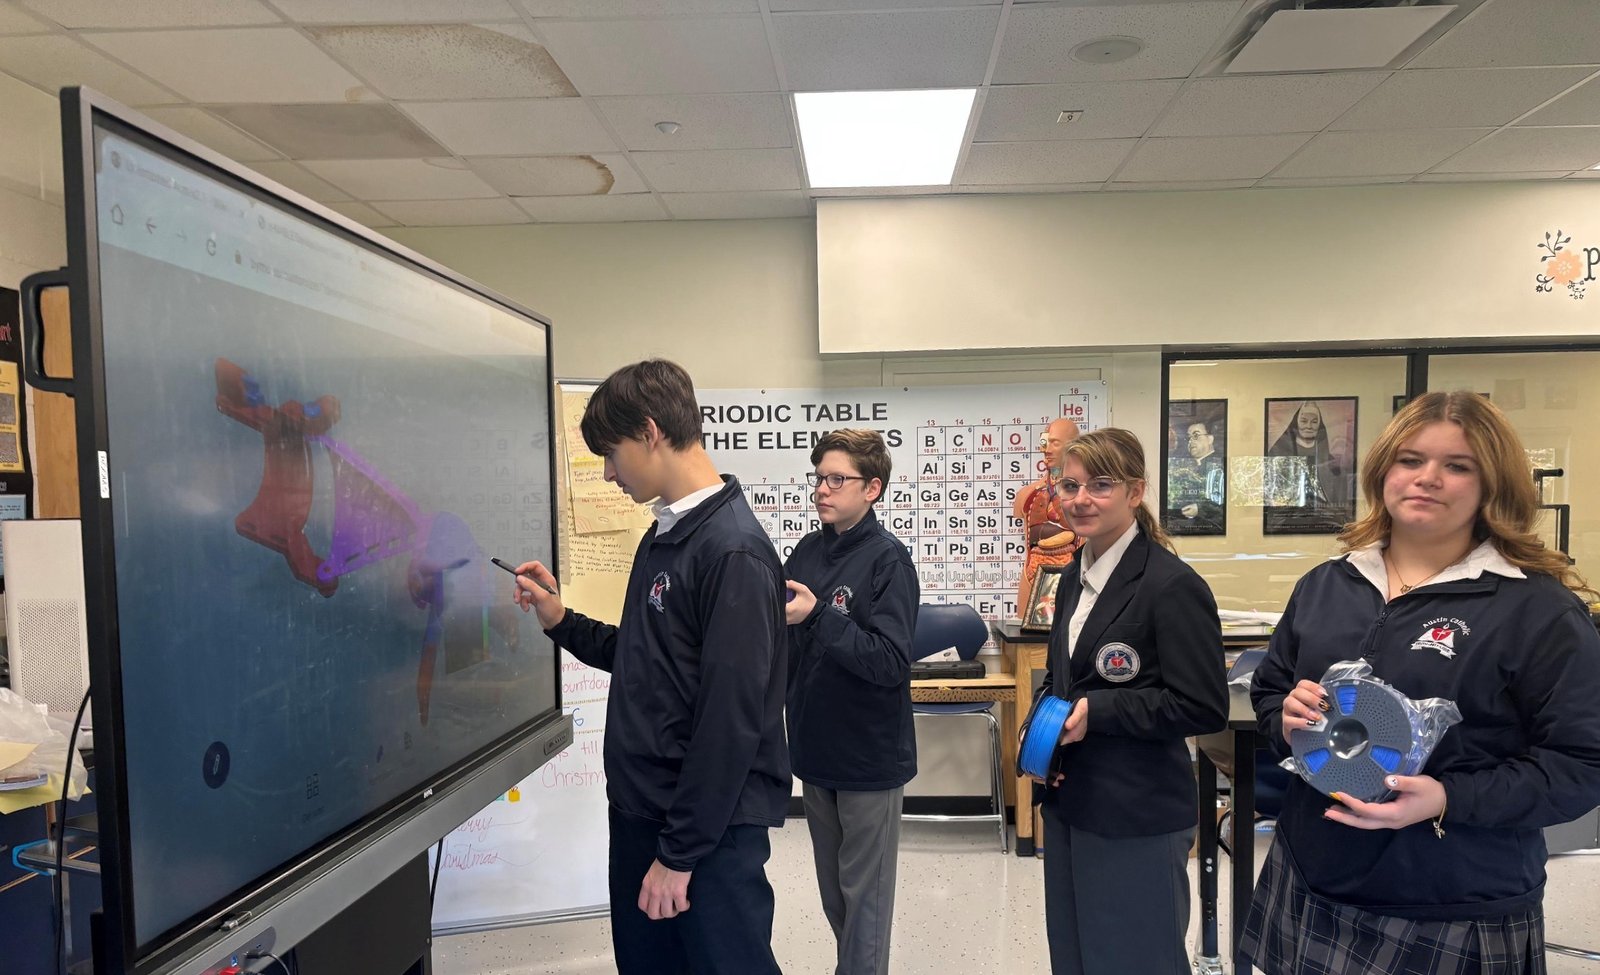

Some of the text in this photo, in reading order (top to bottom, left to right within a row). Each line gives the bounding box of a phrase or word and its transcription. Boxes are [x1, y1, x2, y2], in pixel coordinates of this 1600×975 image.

[700, 402, 888, 424] RIODIC TABLE
[1063, 403, 1083, 416] He
[925, 436, 935, 447] B
[953, 434, 964, 447] C
[982, 434, 992, 446] N
[1010, 433, 1021, 445] O
[923, 462, 938, 474] Al
[952, 462, 966, 474] Si
[982, 462, 992, 473] P
[1010, 461, 1020, 473] S
[1037, 460, 1048, 472] C
[754, 493, 775, 504] Mn
[784, 493, 800, 504] Fe
[893, 491, 912, 502] Zn
[921, 490, 941, 501] Ga
[949, 490, 969, 501] Ge
[977, 489, 997, 500] As
[1006, 488, 1015, 500] S
[783, 520, 802, 531] Ru
[810, 520, 820, 530] R
[893, 518, 913, 529] Cd
[924, 517, 937, 528] In
[949, 516, 968, 528] Sn
[977, 516, 997, 528] Sb
[1006, 516, 1024, 527] Te
[784, 546, 794, 556] O
[924, 544, 938, 555] Tl
[949, 543, 969, 555] Pb
[980, 543, 994, 554] Bi
[1006, 543, 1025, 554] Po
[980, 602, 996, 613] Er
[1004, 602, 1017, 613] T
[1422, 617, 1448, 628] Austin
[562, 662, 588, 672] mas
[542, 762, 606, 788] Christm
